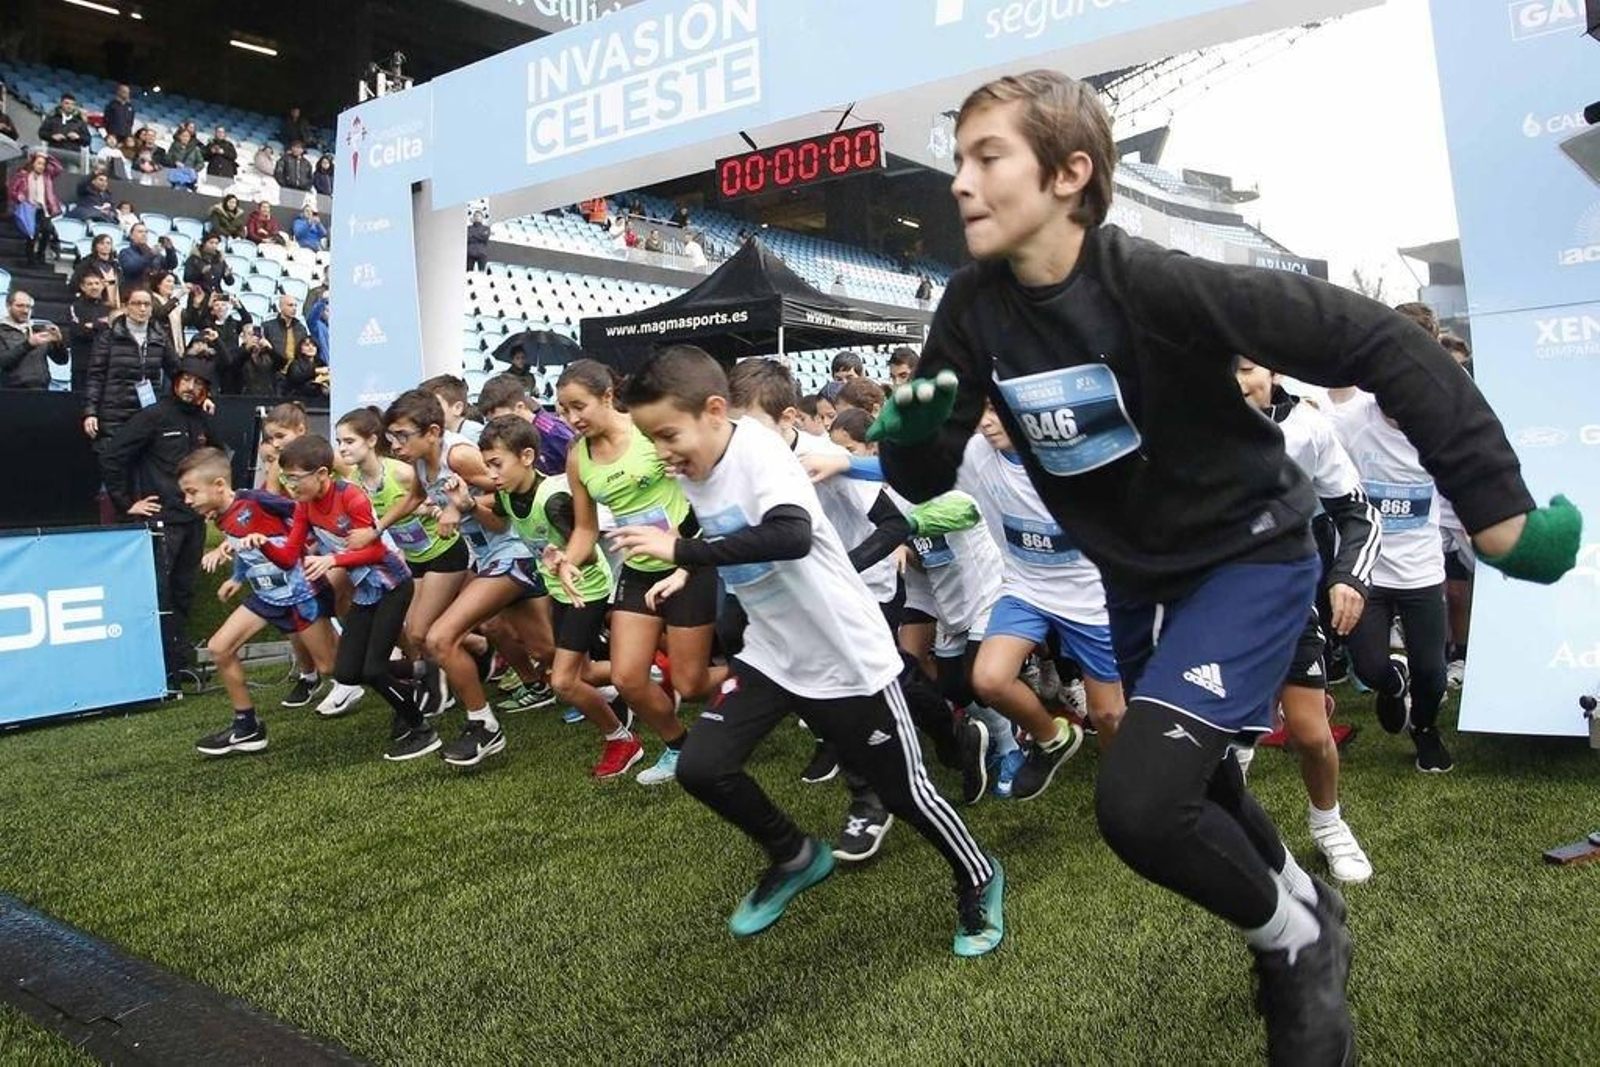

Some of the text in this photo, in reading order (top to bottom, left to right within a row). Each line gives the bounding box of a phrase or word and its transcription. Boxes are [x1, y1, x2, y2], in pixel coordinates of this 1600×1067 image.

[529, 46, 757, 155] CELESTE
[369, 136, 424, 169] Celta
[722, 130, 877, 196] 00:00:00
[605, 310, 749, 337] www.magmasports.es
[1021, 408, 1078, 441] 846
[1381, 499, 1411, 515] 868
[1021, 533, 1053, 549] 864
